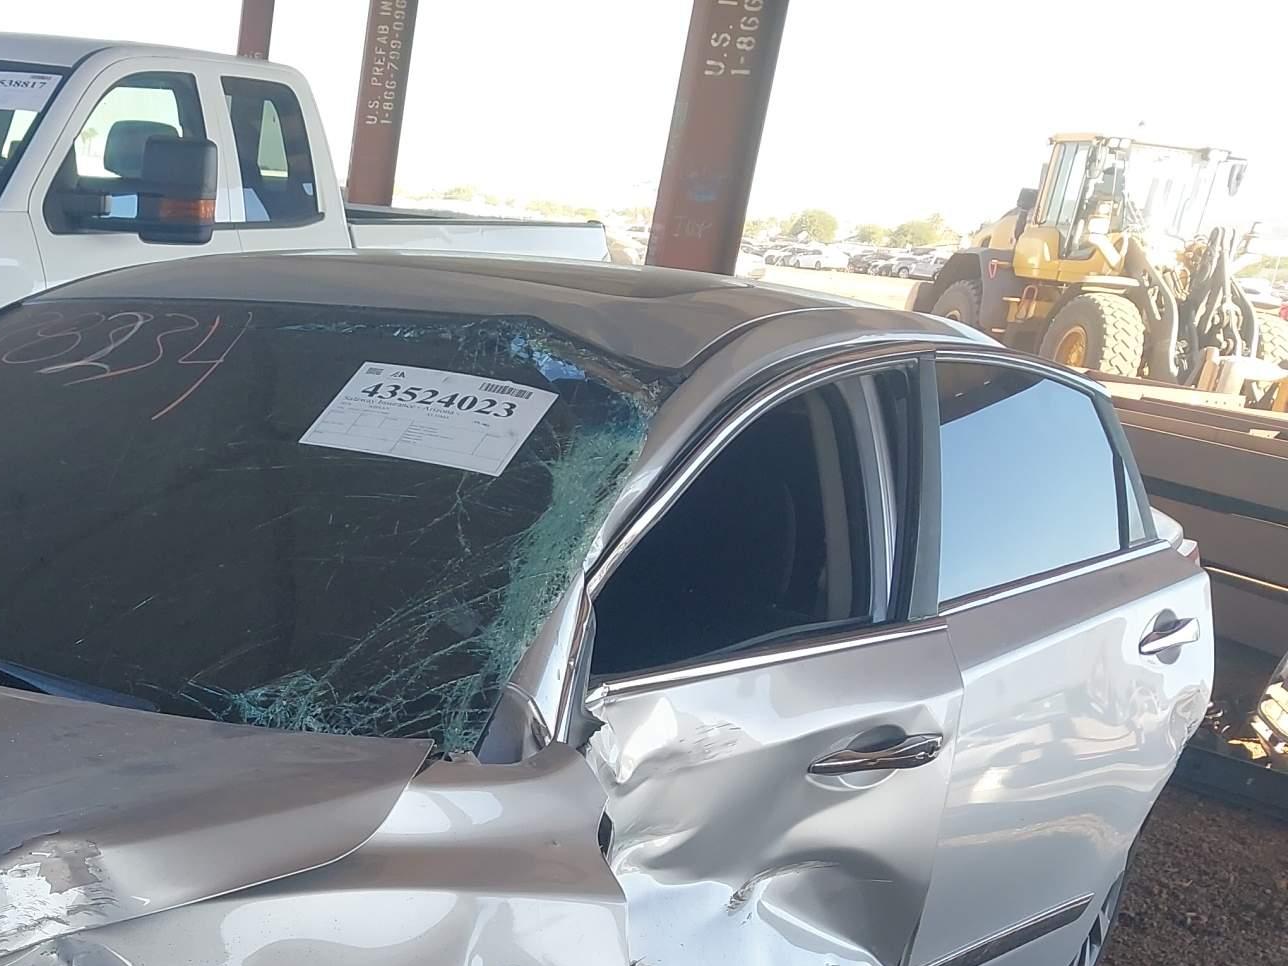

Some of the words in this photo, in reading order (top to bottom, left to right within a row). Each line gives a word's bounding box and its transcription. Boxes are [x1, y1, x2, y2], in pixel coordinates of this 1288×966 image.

[371, 24, 389, 86] PREFAB
[704, 25, 733, 76] U.S.
[365, 96, 381, 125] U.S.
[361, 382, 518, 418] 43524023
